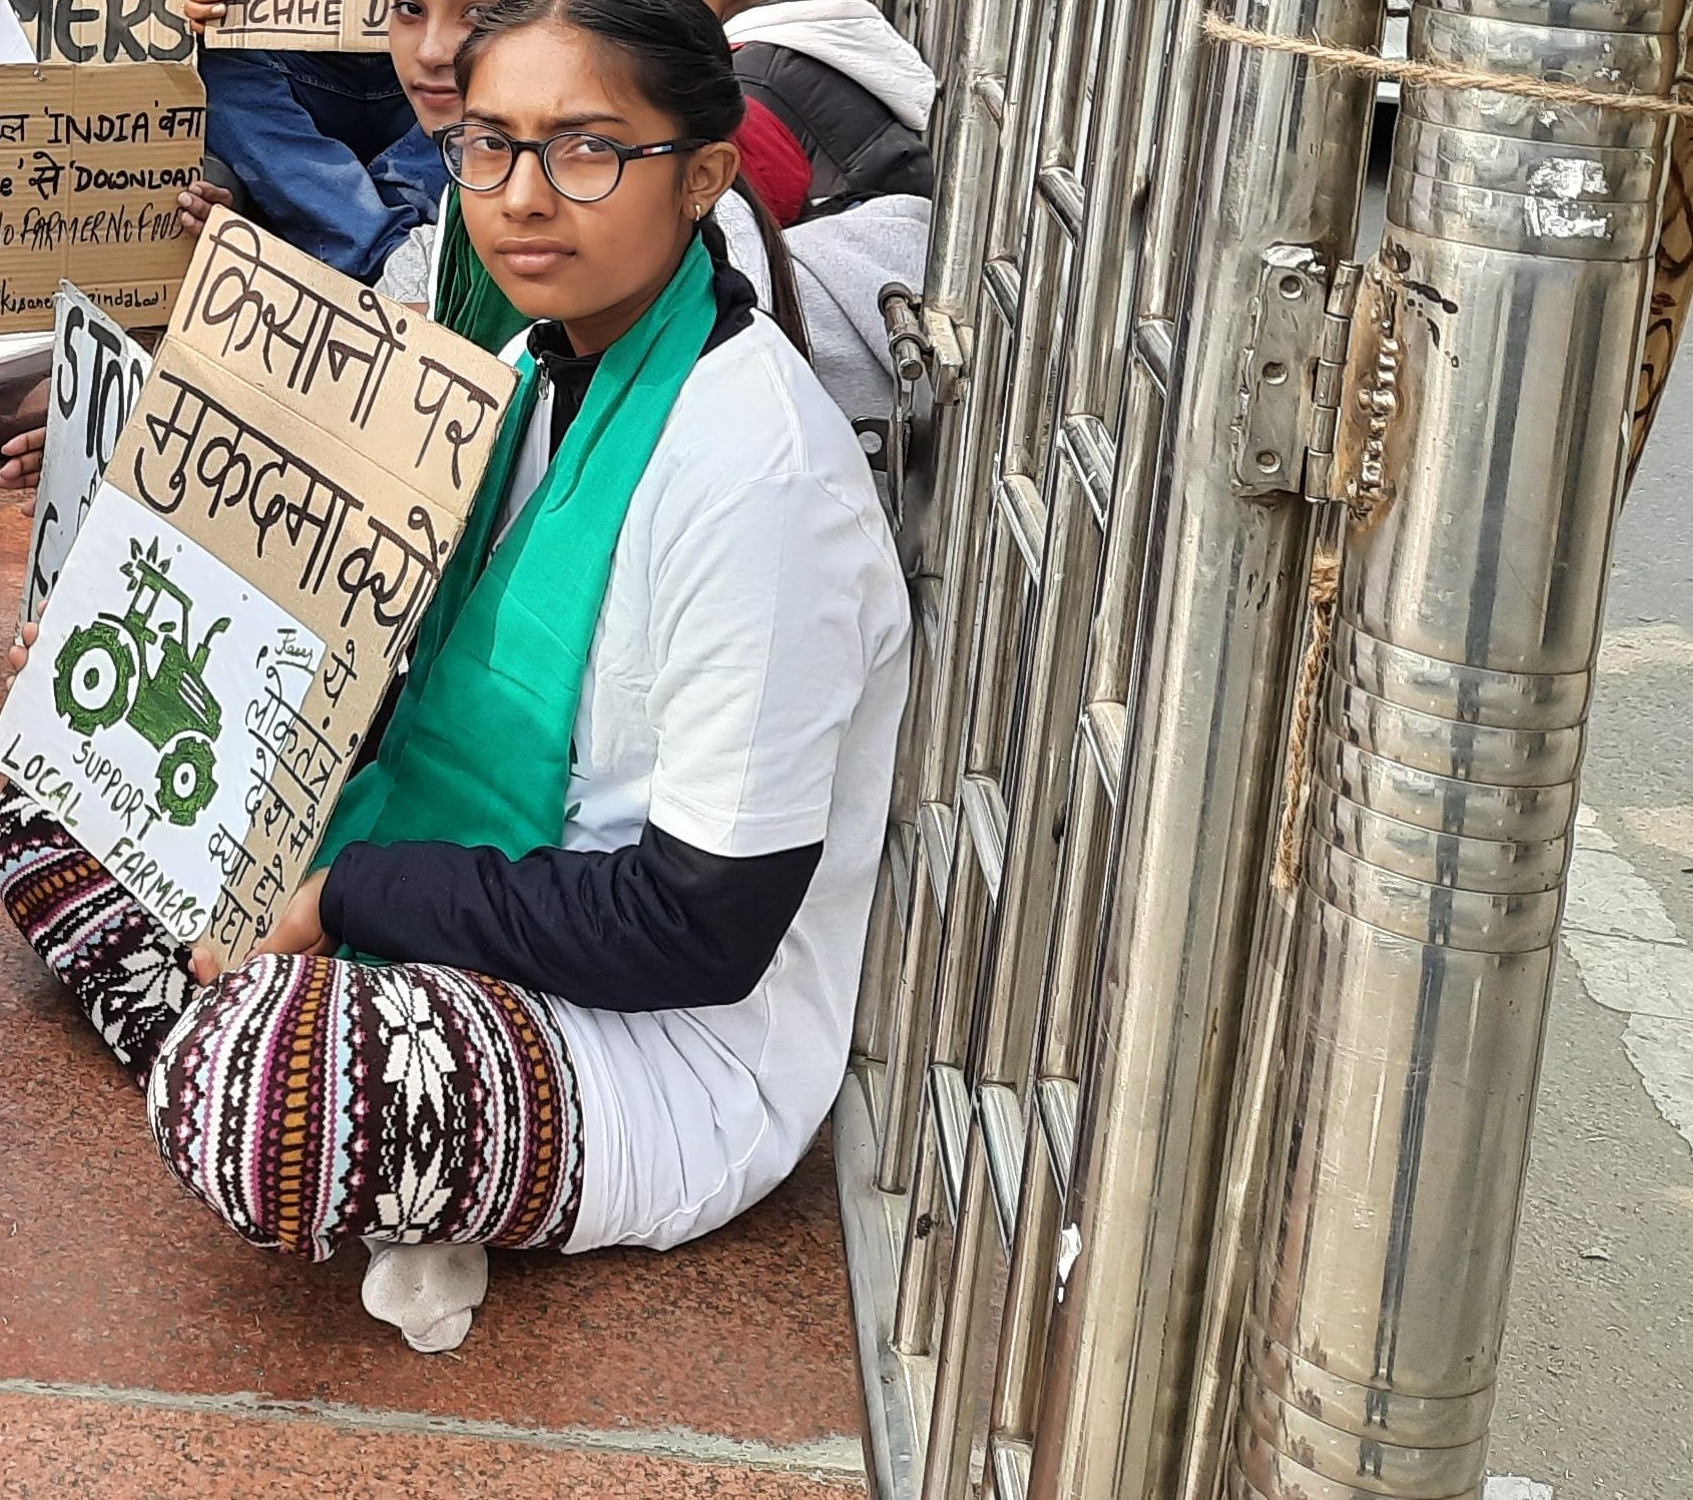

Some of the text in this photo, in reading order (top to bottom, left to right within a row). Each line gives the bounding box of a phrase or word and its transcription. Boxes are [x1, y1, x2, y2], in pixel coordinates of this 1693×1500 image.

[158, 105, 206, 142] बना
[28, 150, 66, 200] से
[181, 218, 501, 491] किसानों पर
[133, 367, 366, 598] मुकदमा
[0, 733, 81, 828] LOCAL
[72, 739, 164, 843] SUPPORT
[244, 747, 294, 839] देश
[105, 835, 207, 943] FARMERS
